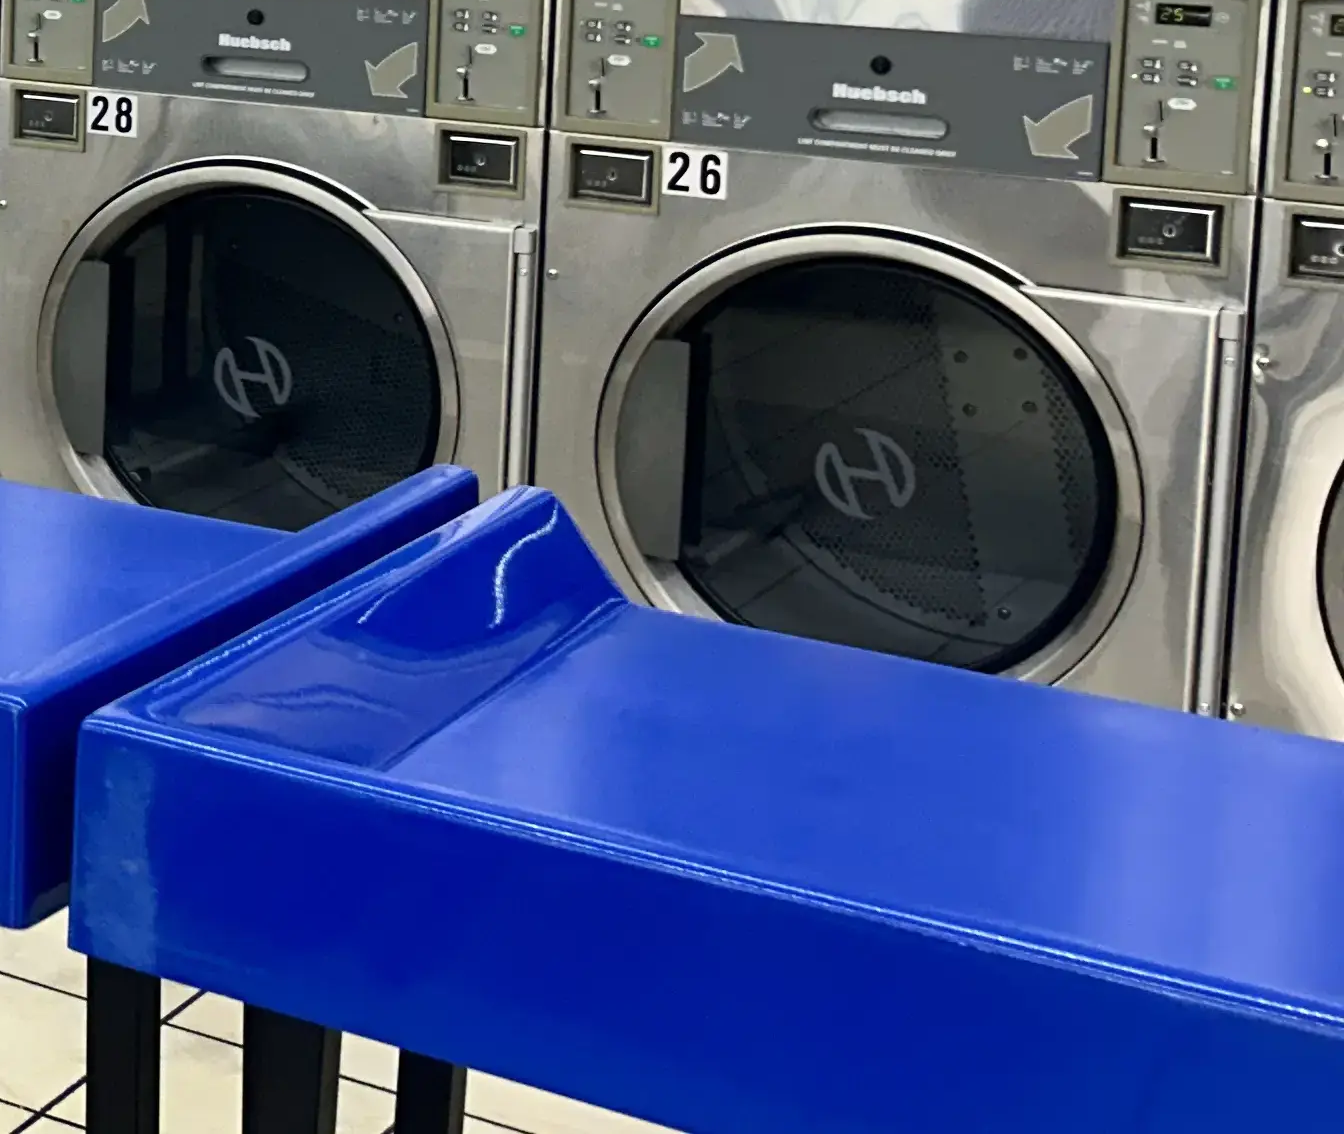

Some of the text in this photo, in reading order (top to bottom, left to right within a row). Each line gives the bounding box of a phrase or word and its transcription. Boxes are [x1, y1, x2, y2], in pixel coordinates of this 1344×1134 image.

[1160, 7, 1183, 22] 25
[218, 32, 292, 52] Huebsch
[832, 81, 928, 105] Huebsch
[90, 94, 134, 134] 28
[667, 151, 721, 195] 26
